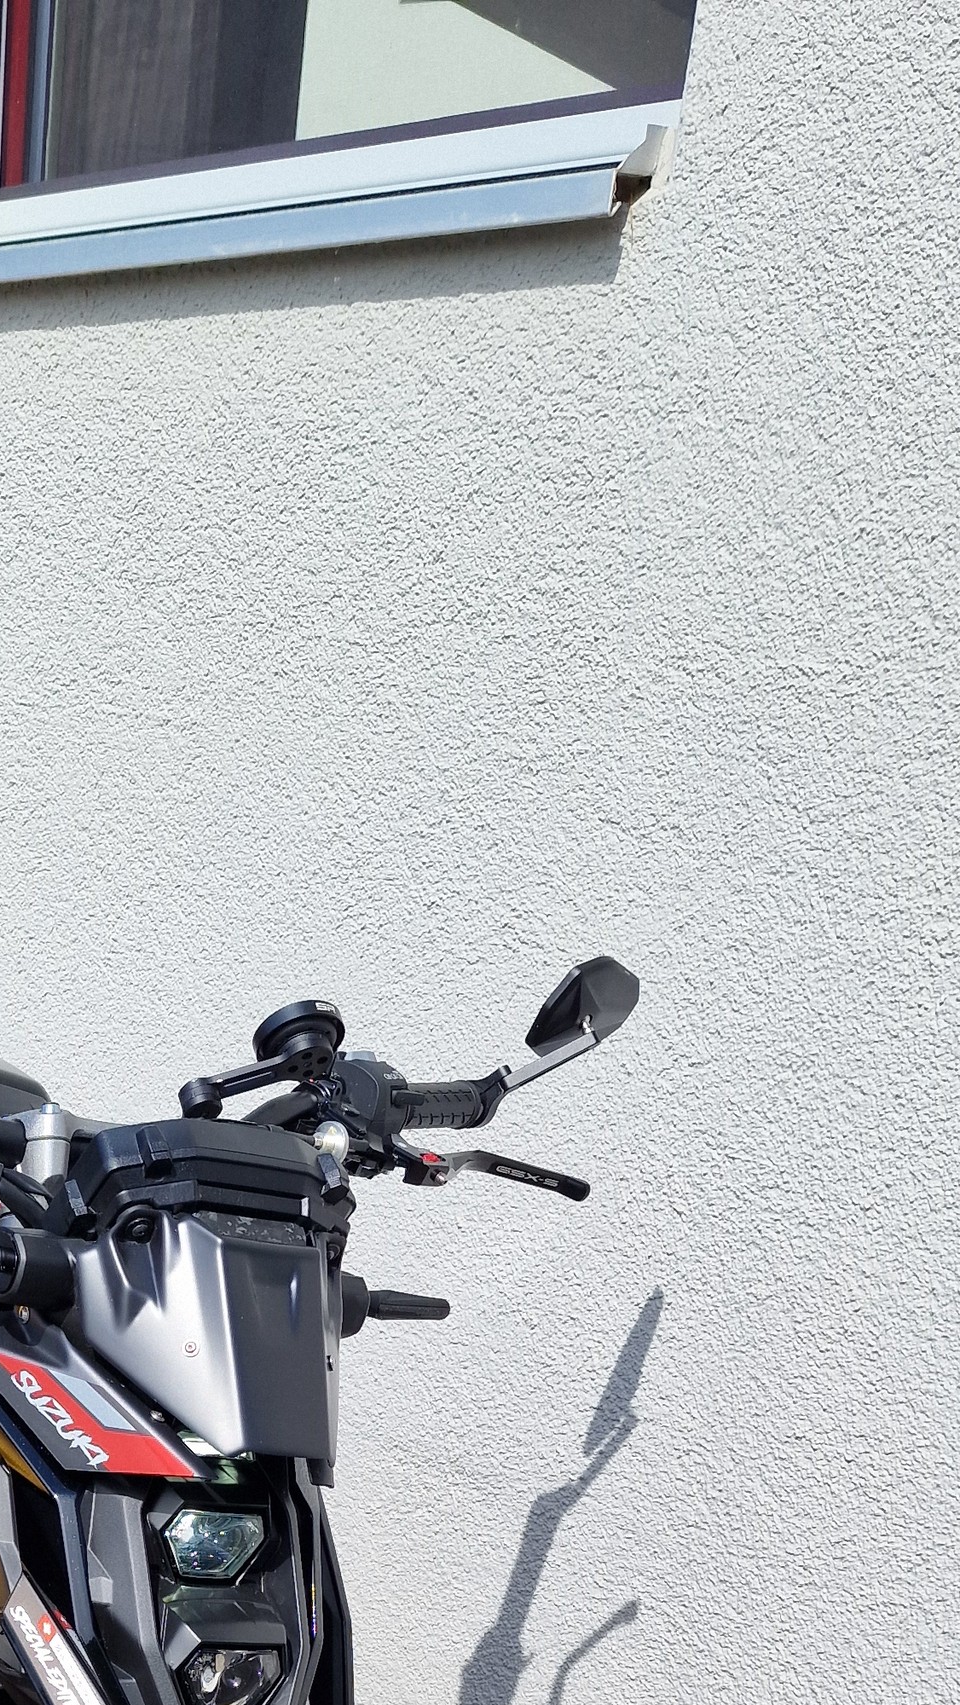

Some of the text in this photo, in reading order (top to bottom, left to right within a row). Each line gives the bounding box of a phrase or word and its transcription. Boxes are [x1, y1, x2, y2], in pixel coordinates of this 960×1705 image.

[496, 1165, 560, 1188] GSX-S
[11, 1370, 110, 1470] SUZUKI
[9, 1605, 55, 1671] SPECIAL
